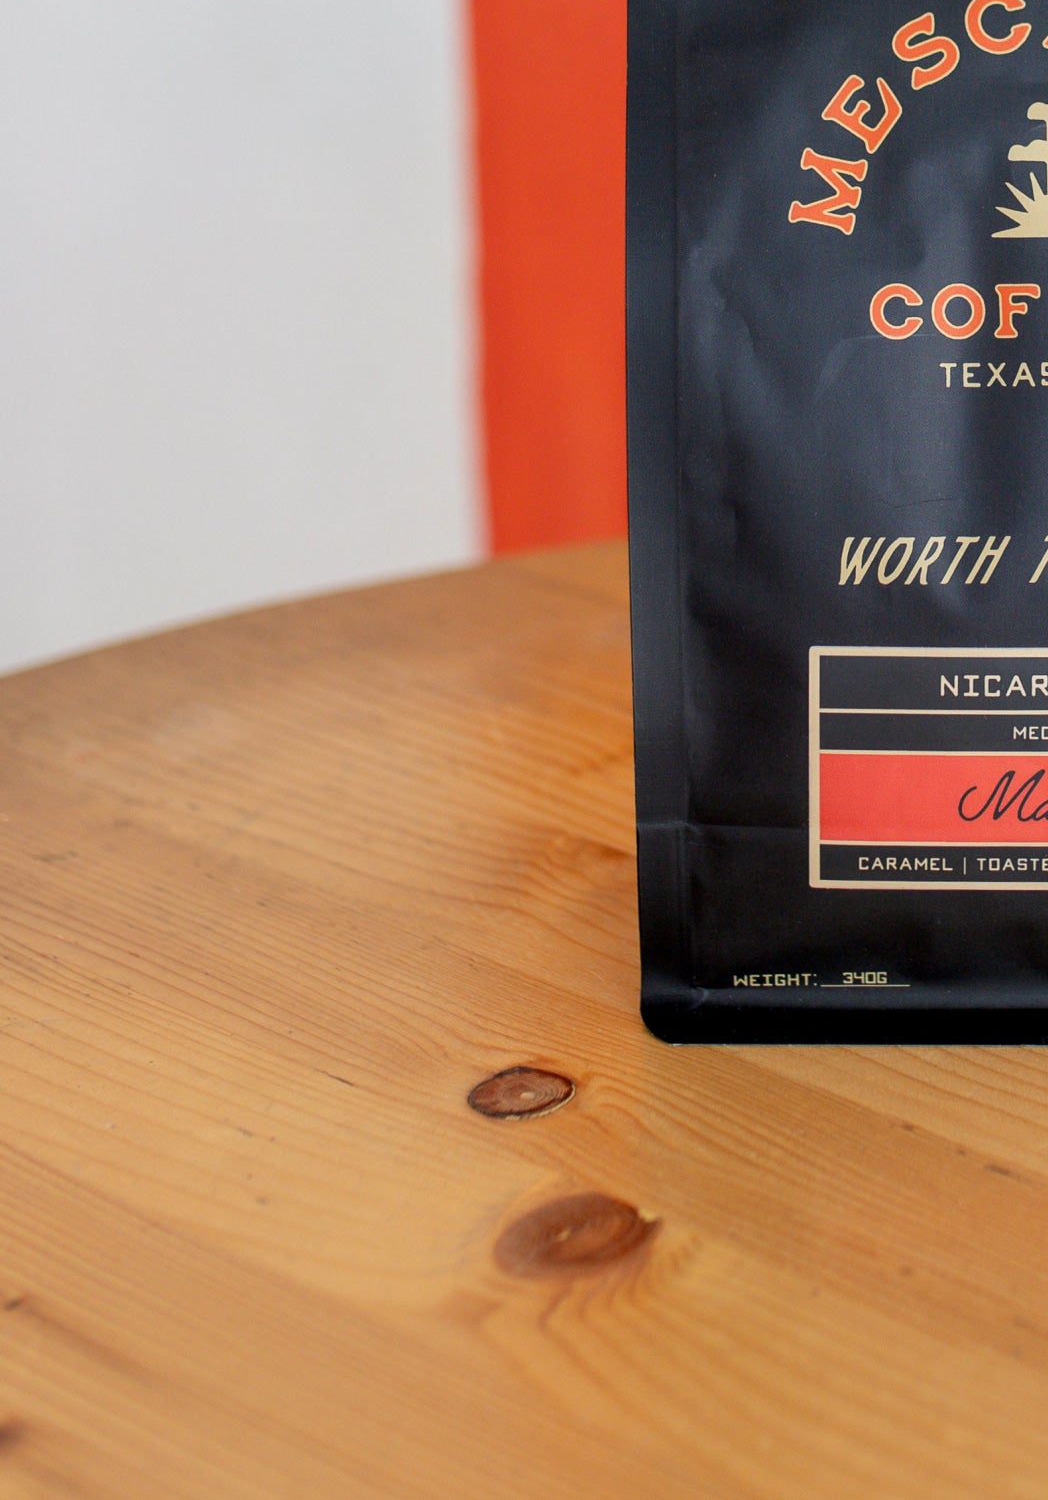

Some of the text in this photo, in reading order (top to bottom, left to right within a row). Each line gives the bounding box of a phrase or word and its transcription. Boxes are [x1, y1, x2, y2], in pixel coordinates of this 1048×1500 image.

[838, 535, 1011, 585] WORTH
[858, 856, 953, 872] CARAMEL
[733, 971, 888, 987] WEIGHT: 340G
